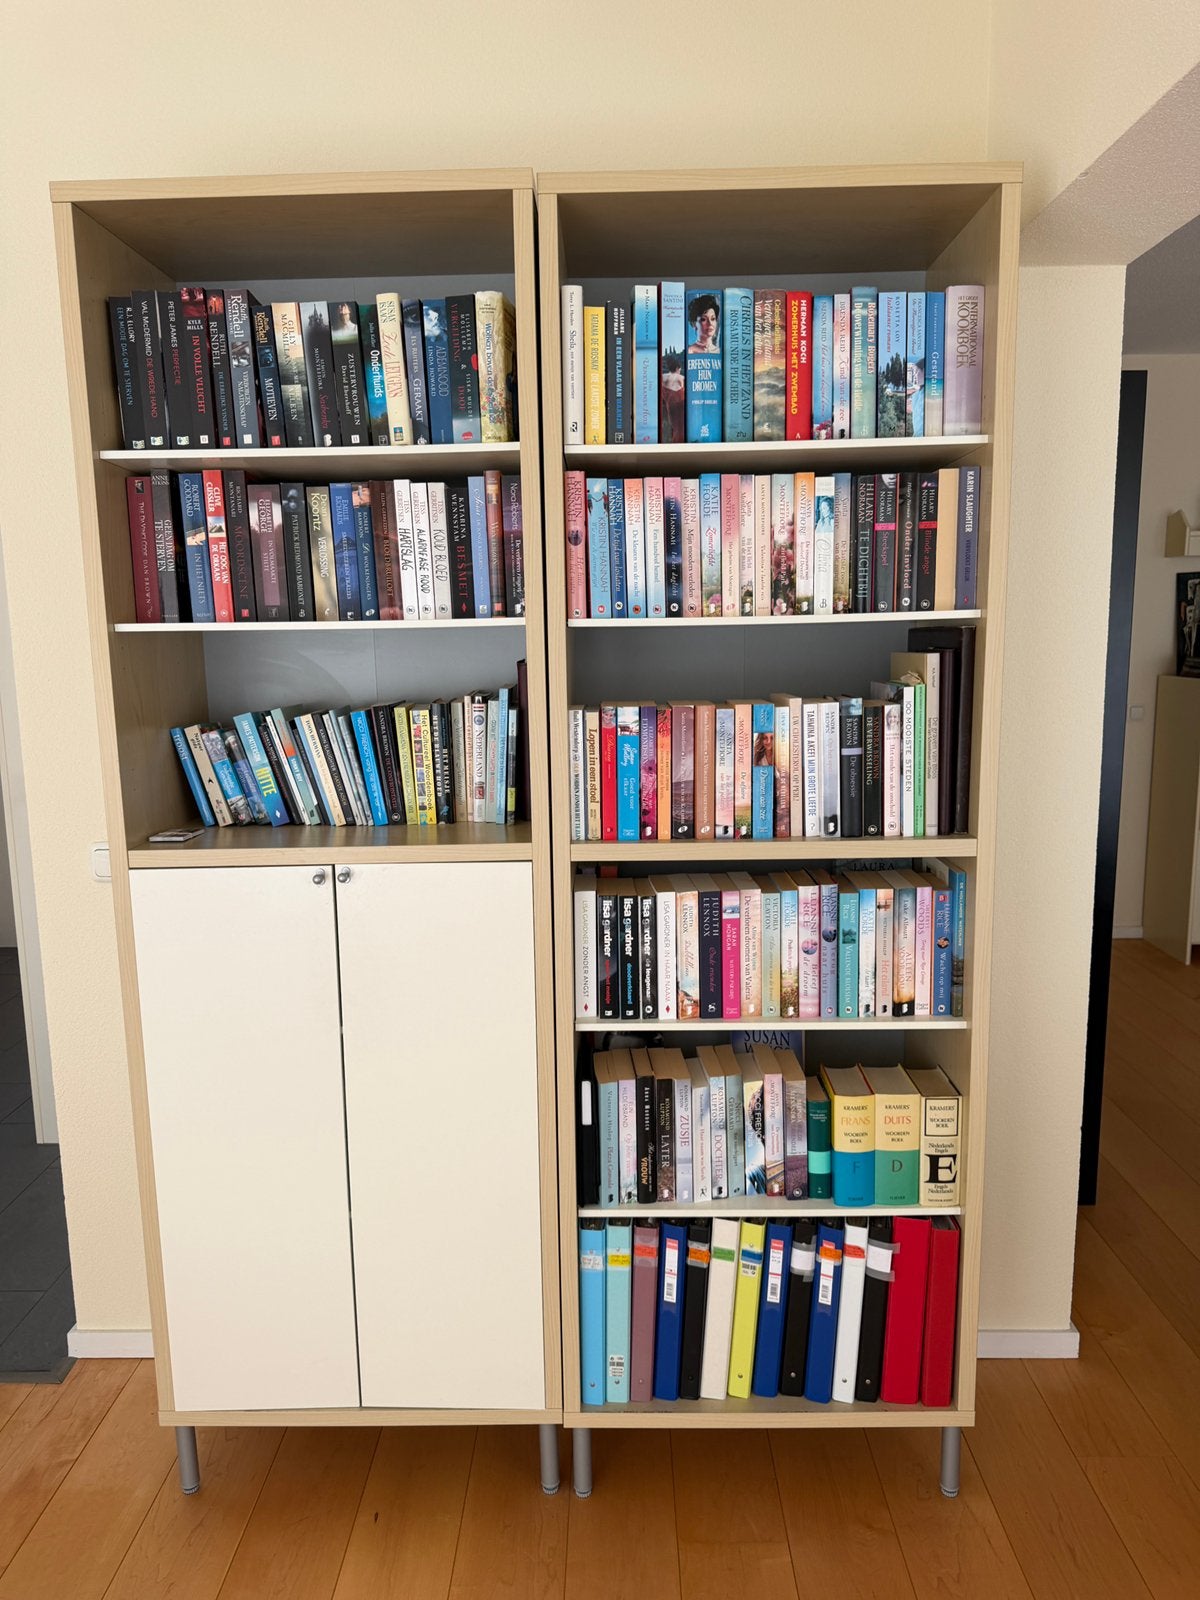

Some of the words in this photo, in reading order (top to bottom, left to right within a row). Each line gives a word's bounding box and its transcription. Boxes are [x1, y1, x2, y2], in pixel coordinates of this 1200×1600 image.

[141, 301, 149, 315] VAL
[168, 301, 176, 321] PETER
[229, 295, 246, 338] Rendell
[239, 303, 248, 321] Ruth
[740, 296, 752, 345] CIRKELS
[839, 301, 847, 331] BRENDA
[866, 303, 877, 343] Rosemary
[127, 320, 137, 343] ELLORY
[143, 317, 155, 356] McDERMID
[170, 324, 178, 347] JAMES
[192, 335, 200, 345] IN
[256, 312, 268, 343] Rendell
[281, 313, 292, 365] MACMILLAN
[287, 320, 297, 345] GILLY
[591, 314, 600, 336] TATIANA
[730, 309, 739, 365] ROSAMUNDE
[956, 301, 970, 368] KOOKBOEK
[969, 302, 979, 368] INTERNATIONAAL
[209, 322, 221, 367] RENDELL
[219, 334, 227, 355] RUTH
[742, 348, 751, 359] IN
[193, 348, 204, 375] VOLLE
[341, 365, 349, 383] David
[370, 350, 383, 398] Onderhuids
[435, 345, 448, 397] ADEMNOOD
[742, 364, 751, 387] HET
[929, 351, 939, 396] Gestrand
[195, 378, 206, 414] VLUCHT
[264, 378, 278, 420] MOTIEVEN
[347, 353, 361, 425] ZUSTERVROUWEN
[413, 378, 424, 422] GERAAKT
[730, 367, 739, 404] PILCHER
[741, 388, 751, 420] ZAND
[213, 487, 221, 506] CLIVE
[966, 471, 975, 492] KARIN
[184, 479, 194, 516] GODDARD
[191, 485, 200, 511] ROBERT
[207, 482, 216, 512] CUSSLER
[311, 493, 324, 531] Koontz
[319, 494, 328, 517] Dean
[567, 476, 576, 522] HANNAH
[575, 480, 583, 518] KRISTIN
[609, 486, 617, 525] HANNAH
[616, 488, 624, 522] KRISTIN
[648, 486, 656, 525] HANNAH
[654, 488, 662, 522] KRISTIN
[689, 488, 697, 523] KRISTIN
[703, 483, 711, 518] FFORDE
[711, 486, 719, 514] KATIE
[858, 483, 867, 523] NORMAN
[866, 483, 874, 522] HILARY
[155, 520, 163, 532] TE
[259, 499, 267, 533] GEORGE
[451, 493, 461, 542] WENNSTAM
[458, 497, 467, 539] KATARINA
[511, 503, 520, 530] Roberts
[965, 494, 973, 533] SLAUGHTER
[164, 520, 172, 541] GEEN
[433, 529, 446, 551] KOUD
[860, 529, 870, 541] TE
[904, 521, 913, 552] Onder
[156, 534, 166, 571] STERVEN
[166, 542, 174, 558] DAG
[220, 557, 228, 570] OOG
[318, 537, 329, 577] VERLOSSING
[399, 528, 414, 571] HARTSLAG
[416, 529, 429, 571] ALARMFASE
[168, 560, 175, 571] OM
[435, 554, 448, 582] BLOED
[457, 545, 469, 598] BESMET
[857, 547, 869, 598] DICHTBIJ
[420, 575, 430, 594] ROOD
[240, 720, 250, 737] JAMES
[380, 711, 388, 734] SANDRA
[432, 732, 438, 741] DE
[866, 717, 873, 728] DE
[422, 730, 430, 762] Cultureel
[587, 729, 597, 756] Lopen
[589, 757, 598, 766] in
[850, 756, 857, 767] De
[256, 767, 276, 796] HITTE
[424, 764, 434, 810] Woordenboek
[442, 765, 450, 794] MEISJE
[590, 784, 599, 803] stoel
[853, 862, 895, 872] LAURA
[603, 900, 612, 918] lisa
[624, 898, 633, 917] lisa
[643, 899, 652, 917] lisa
[744, 896, 752, 905] De
[822, 895, 831, 916] RICE
[703, 898, 711, 936] LENNOX
[712, 898, 720, 936] JUDITH
[744, 907, 753, 934] verloren
[918, 900, 926, 934] WOODS
[602, 919, 613, 956] gardner
[622, 918, 634, 956] gardner
[641, 919, 652, 955] gardner
[745, 977, 753, 1000] Valeria
[938, 977, 945, 985] op
[744, 1030, 790, 1046] SUSAN
[680, 1115, 689, 1147] ZUSJE
[841, 1116, 870, 1126] FRANS
[884, 1115, 912, 1125] DUITS
[662, 1135, 670, 1167] LATER
[714, 1135, 723, 1179] DOCHTER
[892, 1159, 903, 1172] D
[853, 1161, 861, 1174] F
[924, 1154, 958, 1184] E
